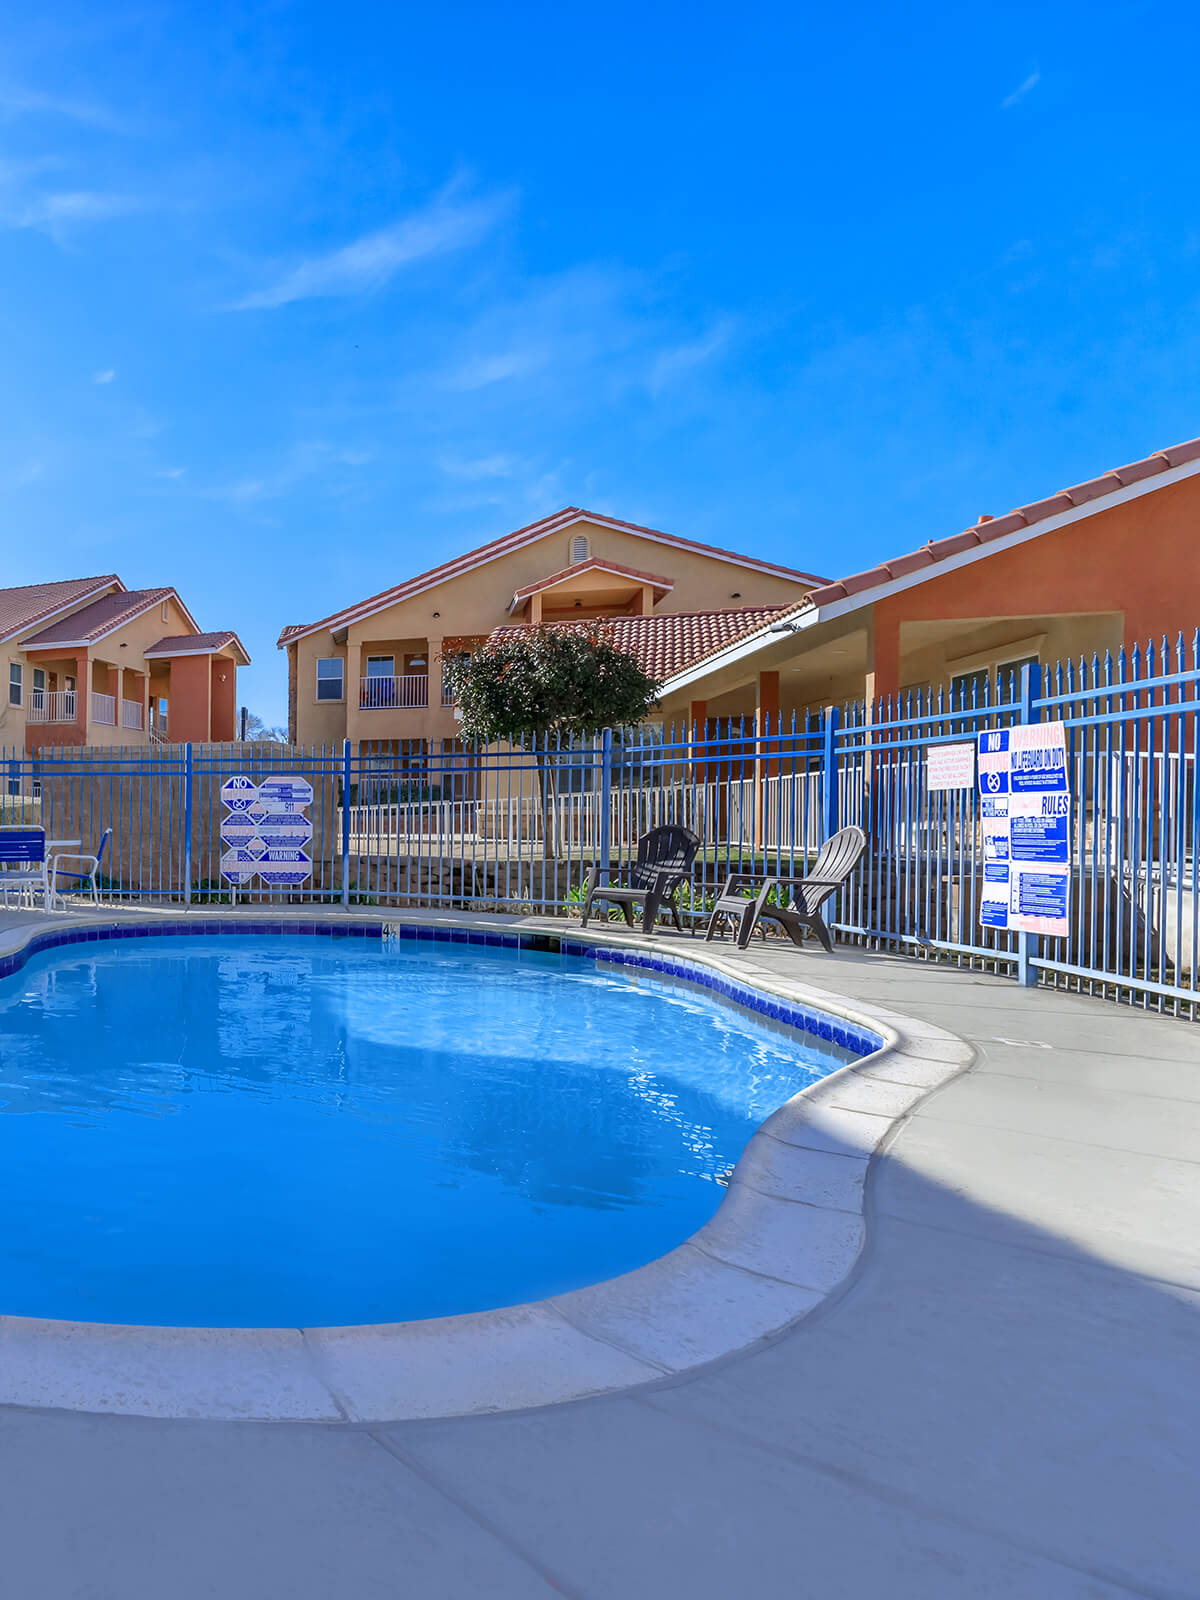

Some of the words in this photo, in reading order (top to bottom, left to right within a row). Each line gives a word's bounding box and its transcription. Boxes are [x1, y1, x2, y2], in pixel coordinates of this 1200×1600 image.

[987, 732, 1001, 752] NO
[1013, 725, 1064, 749] WARNING!
[979, 752, 1009, 773] DIVING
[1011, 751, 1018, 769] NO
[1018, 748, 1043, 769] LIFEGUARD
[1044, 748, 1052, 767] ON
[1052, 747, 1065, 767] DUTY
[233, 778, 247, 788] NO
[284, 802, 295, 813] 911
[995, 809, 1008, 817] POOL
[1041, 795, 1069, 815] RULES
[268, 851, 300, 861] WARNING
